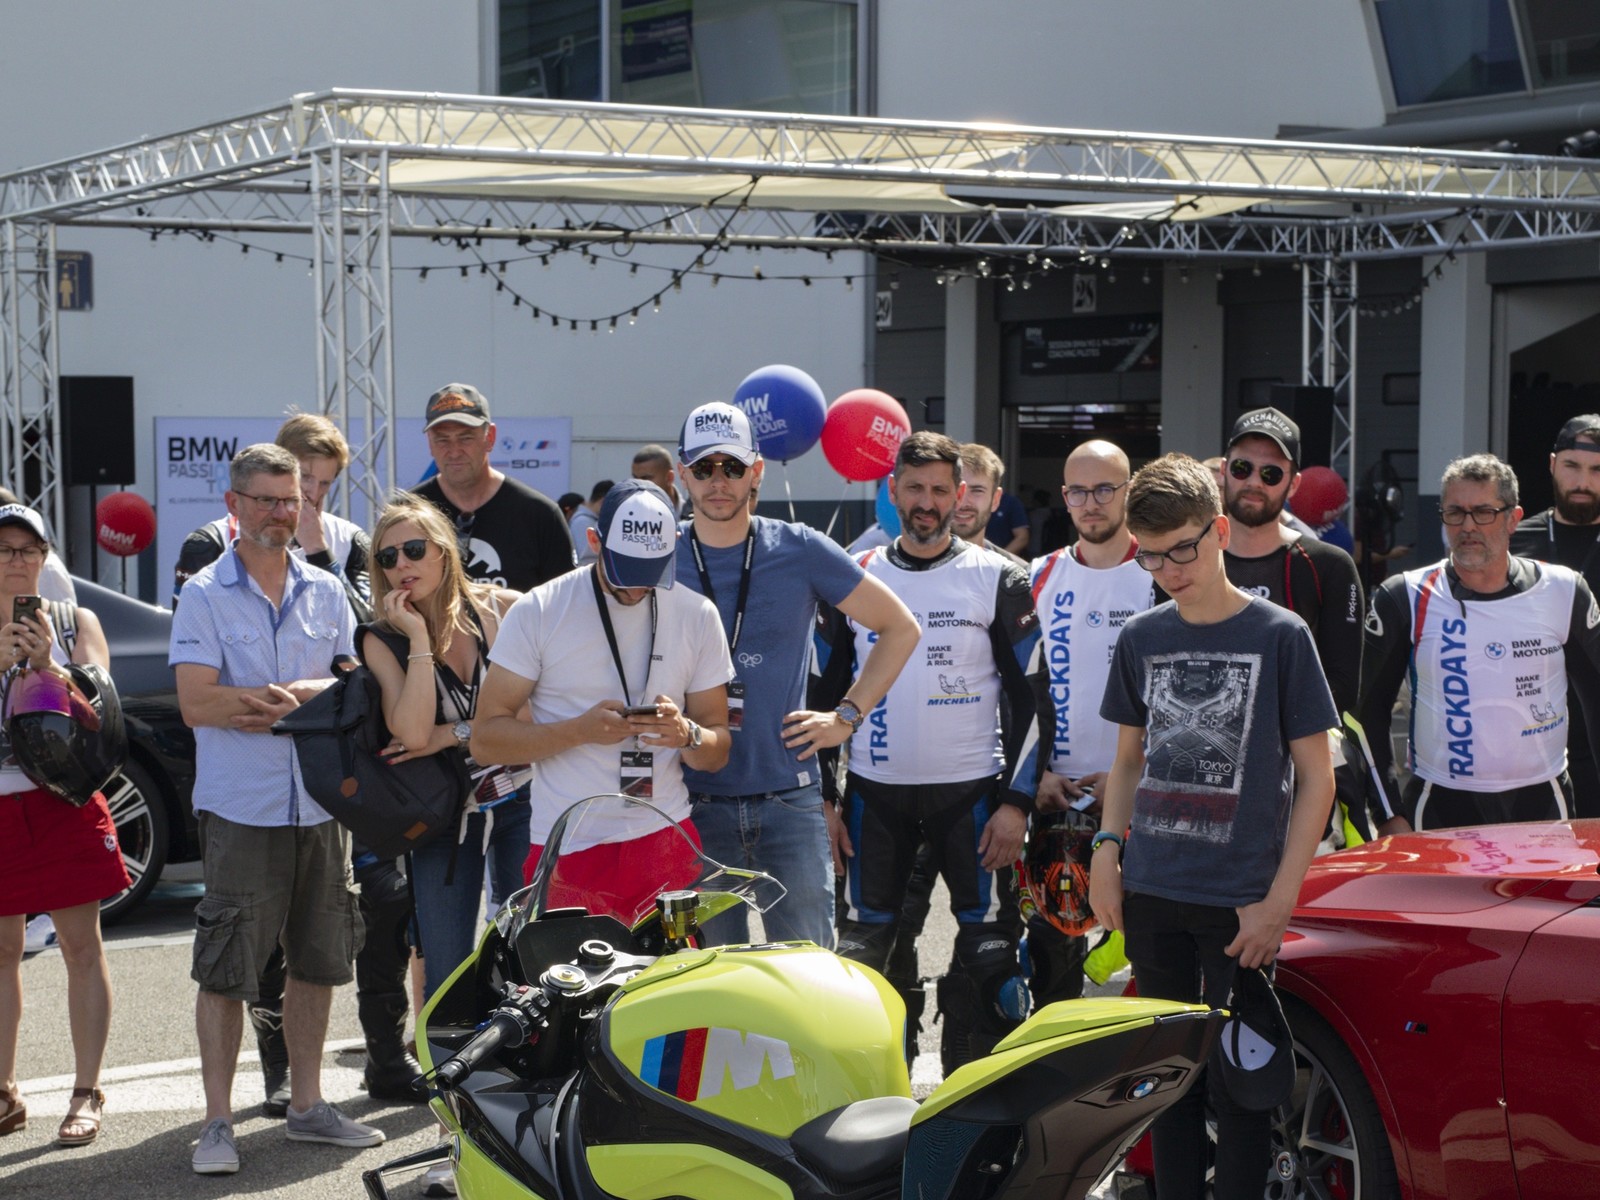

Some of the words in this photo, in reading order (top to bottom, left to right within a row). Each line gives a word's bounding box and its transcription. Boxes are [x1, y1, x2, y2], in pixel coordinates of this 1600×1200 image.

[734, 393, 769, 415] MW
[694, 412, 733, 427] BMW
[694, 423, 734, 434] PASSION
[716, 430, 741, 440] TOUR
[168, 437, 238, 462] BMW
[168, 463, 230, 478] PASSIO
[0, 505, 26, 515] MW
[622, 519, 663, 535] BMW
[100, 524, 136, 545] BMW
[622, 533, 663, 544] PASSION
[644, 543, 667, 552] TOUR
[928, 611, 955, 620] BMW
[1109, 610, 1135, 618] BMW
[1511, 638, 1542, 649] BMW
[927, 652, 944, 660] LIFE
[1049, 590, 1075, 761] TRACKDAYS
[1515, 674, 1540, 683] MAKE
[1516, 682, 1533, 690] LIFE
[1524, 687, 1542, 697] RIDE
[927, 695, 982, 706] MICHELIN
[1441, 618, 1474, 780] RACKDAYS
[1521, 715, 1564, 737] MICHELIN
[1198, 759, 1233, 773] TOKYO
[698, 1027, 797, 1099] M
